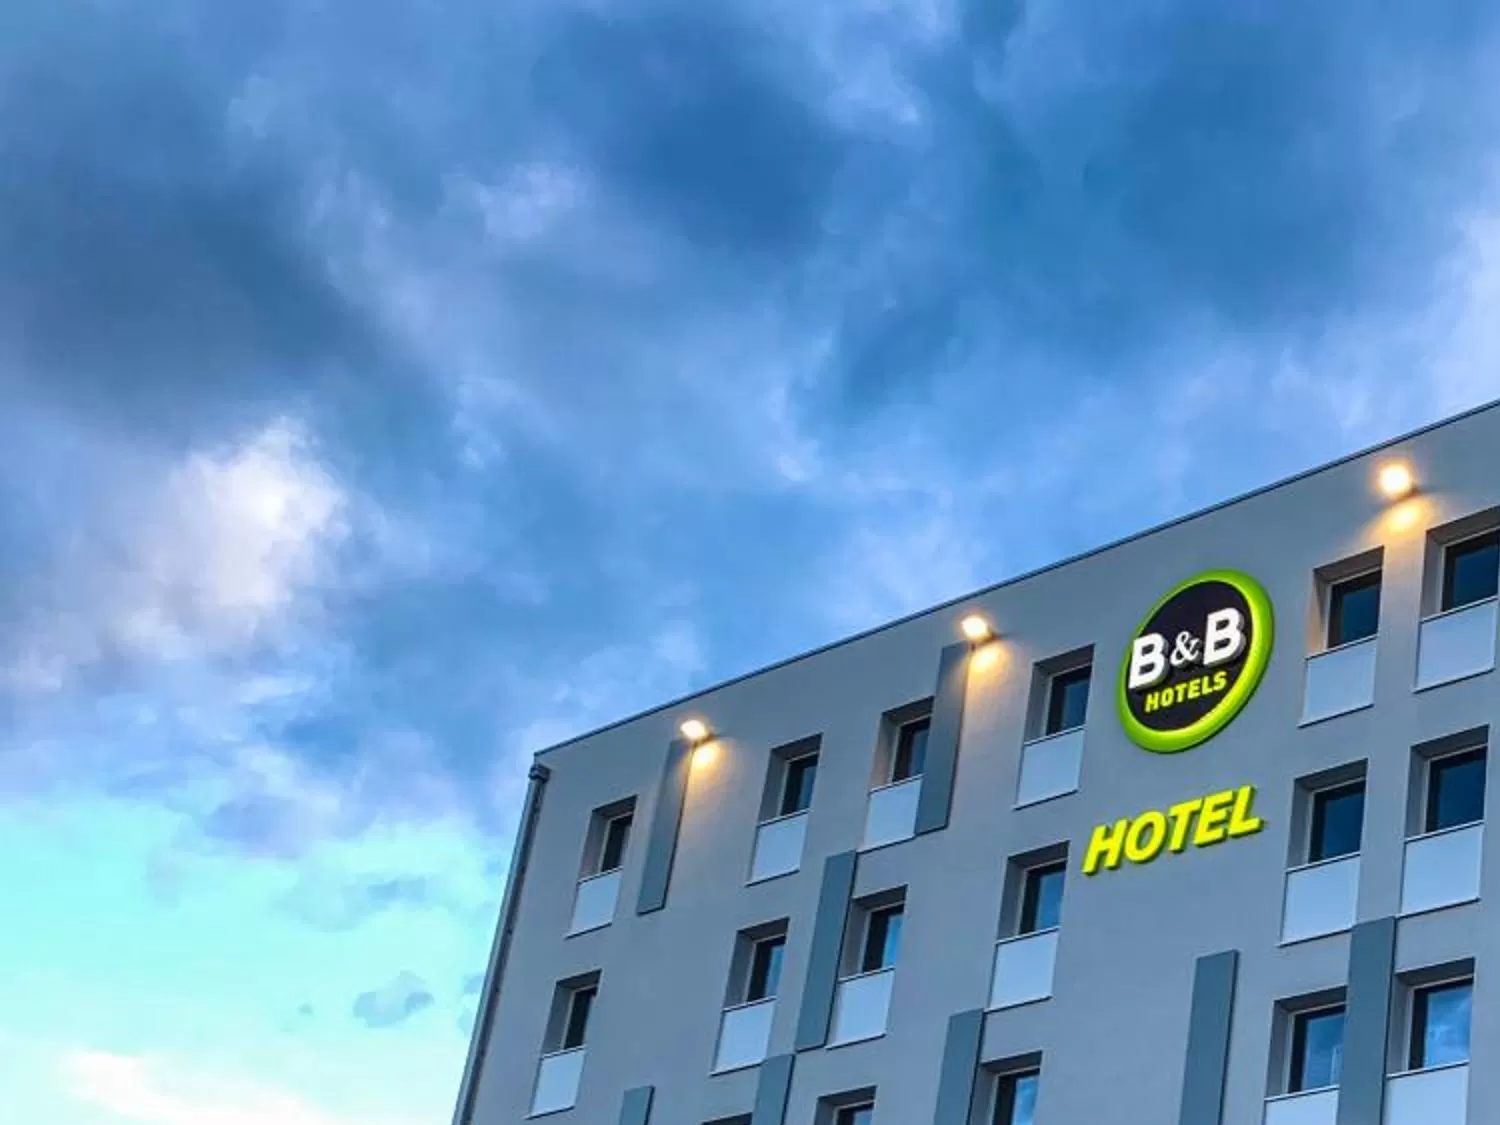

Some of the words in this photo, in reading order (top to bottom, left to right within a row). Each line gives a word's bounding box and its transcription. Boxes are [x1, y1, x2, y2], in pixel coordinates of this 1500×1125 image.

[1128, 607, 1245, 689] B&B
[1144, 671, 1229, 713] HOTELS
[1082, 785, 1262, 874] HOTEL
